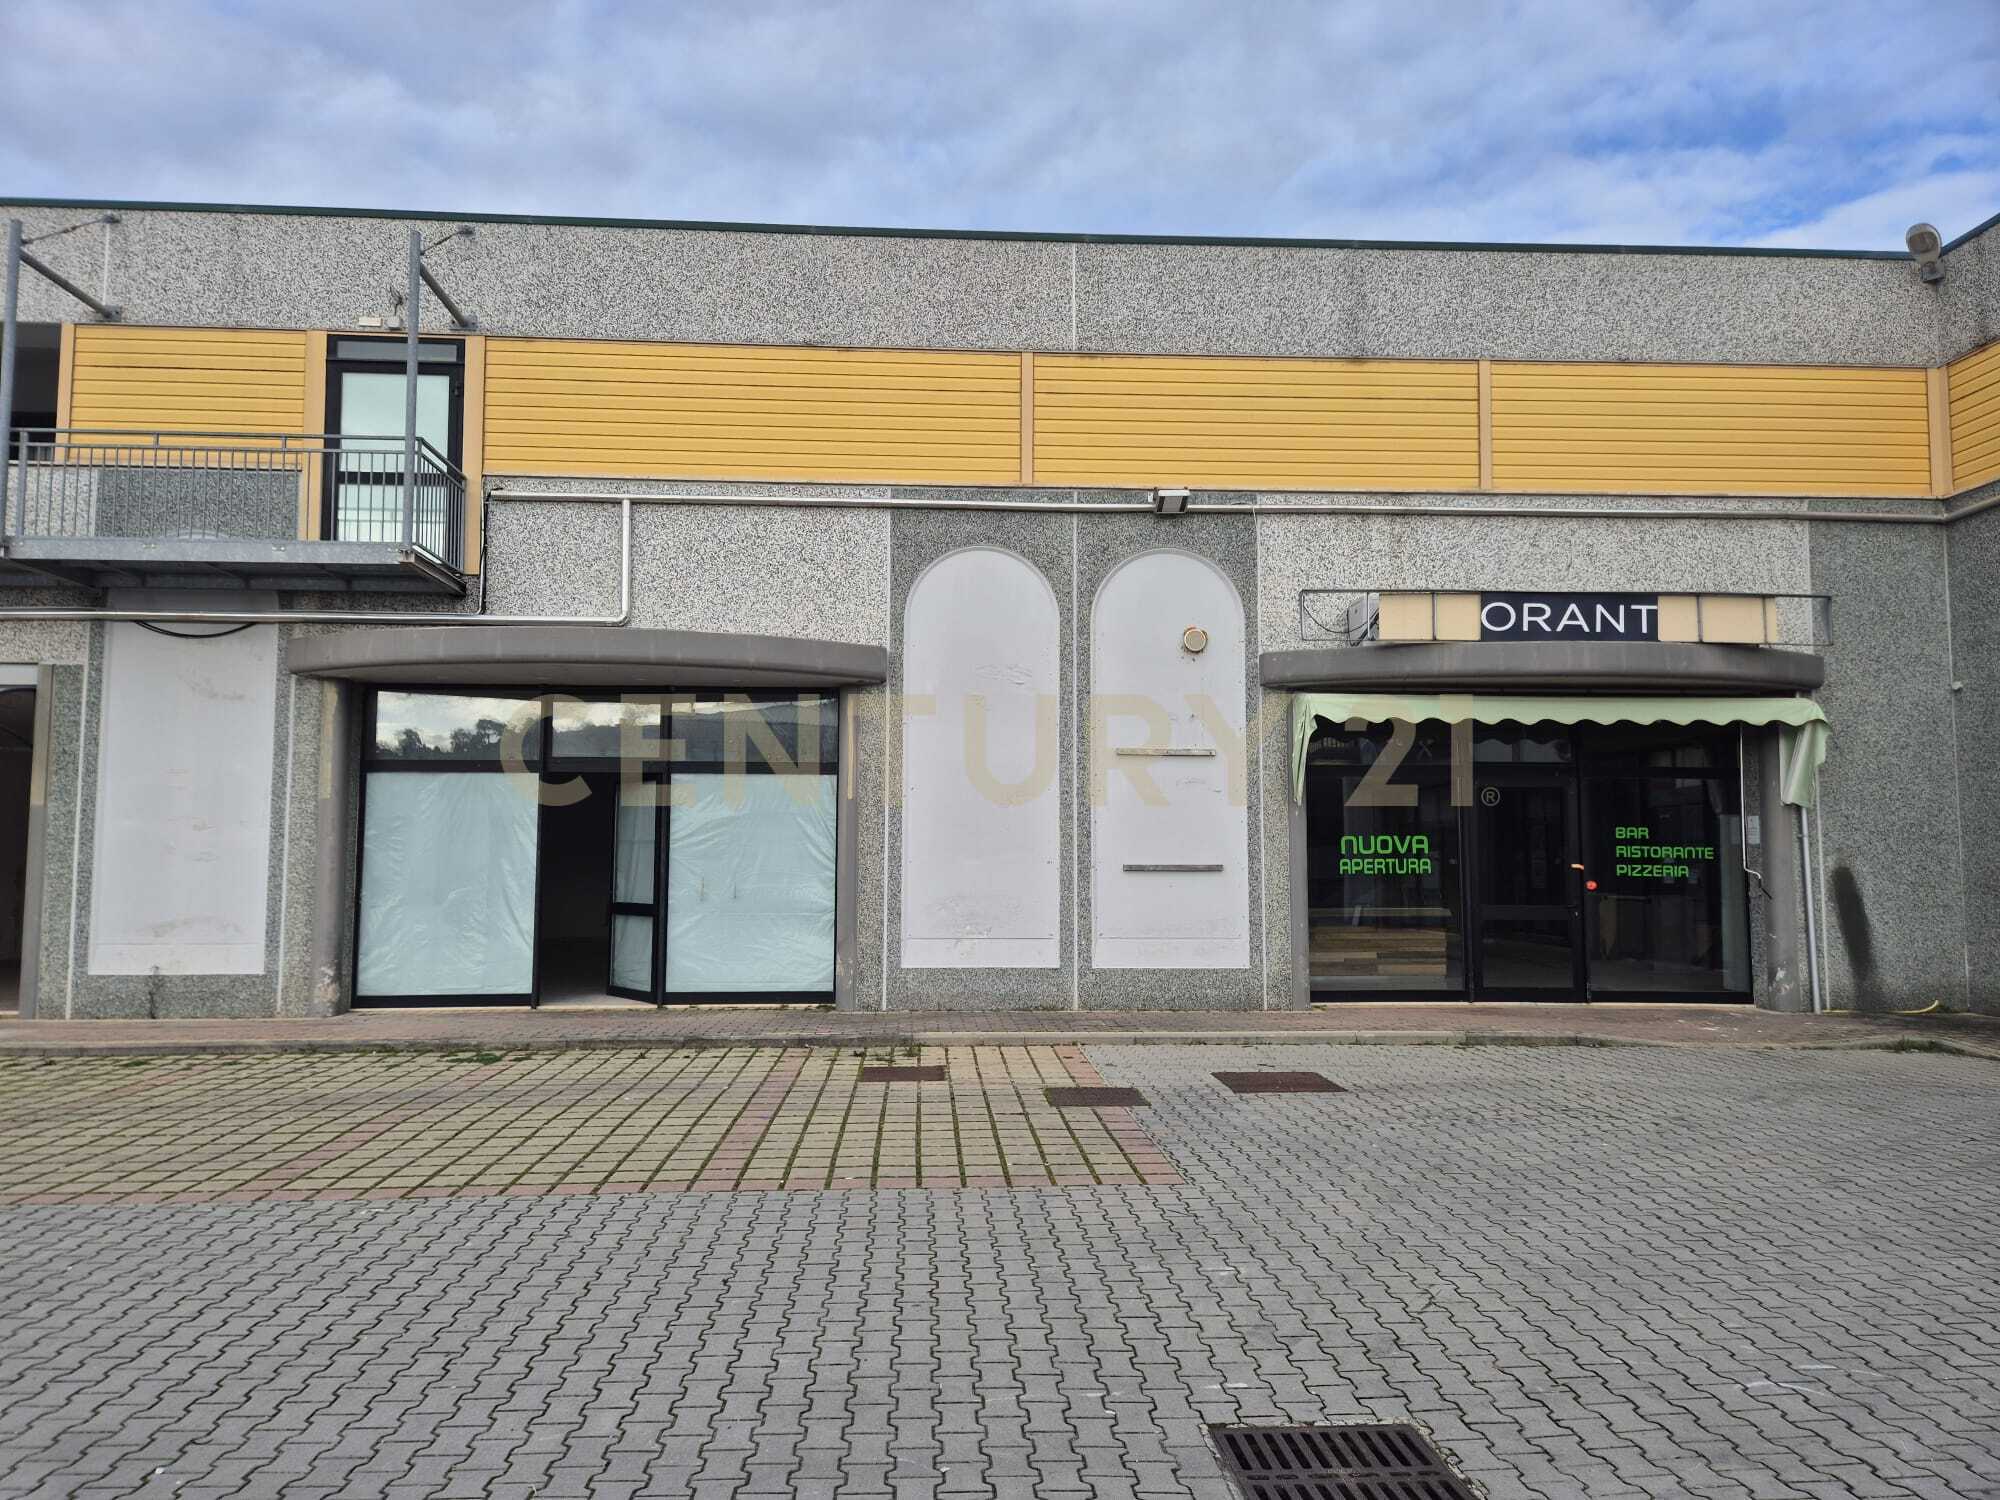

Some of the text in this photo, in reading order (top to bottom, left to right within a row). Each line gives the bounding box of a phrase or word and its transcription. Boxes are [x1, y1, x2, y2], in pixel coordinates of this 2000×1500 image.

[1480, 601, 1658, 634] ORANT
[1615, 826, 1649, 840] BAR
[1340, 835, 1429, 855] NUOVA
[1615, 845, 1714, 860] RISTORANTE
[1339, 858, 1431, 875] APERTURA
[1616, 864, 1690, 878] PIZZERIA
